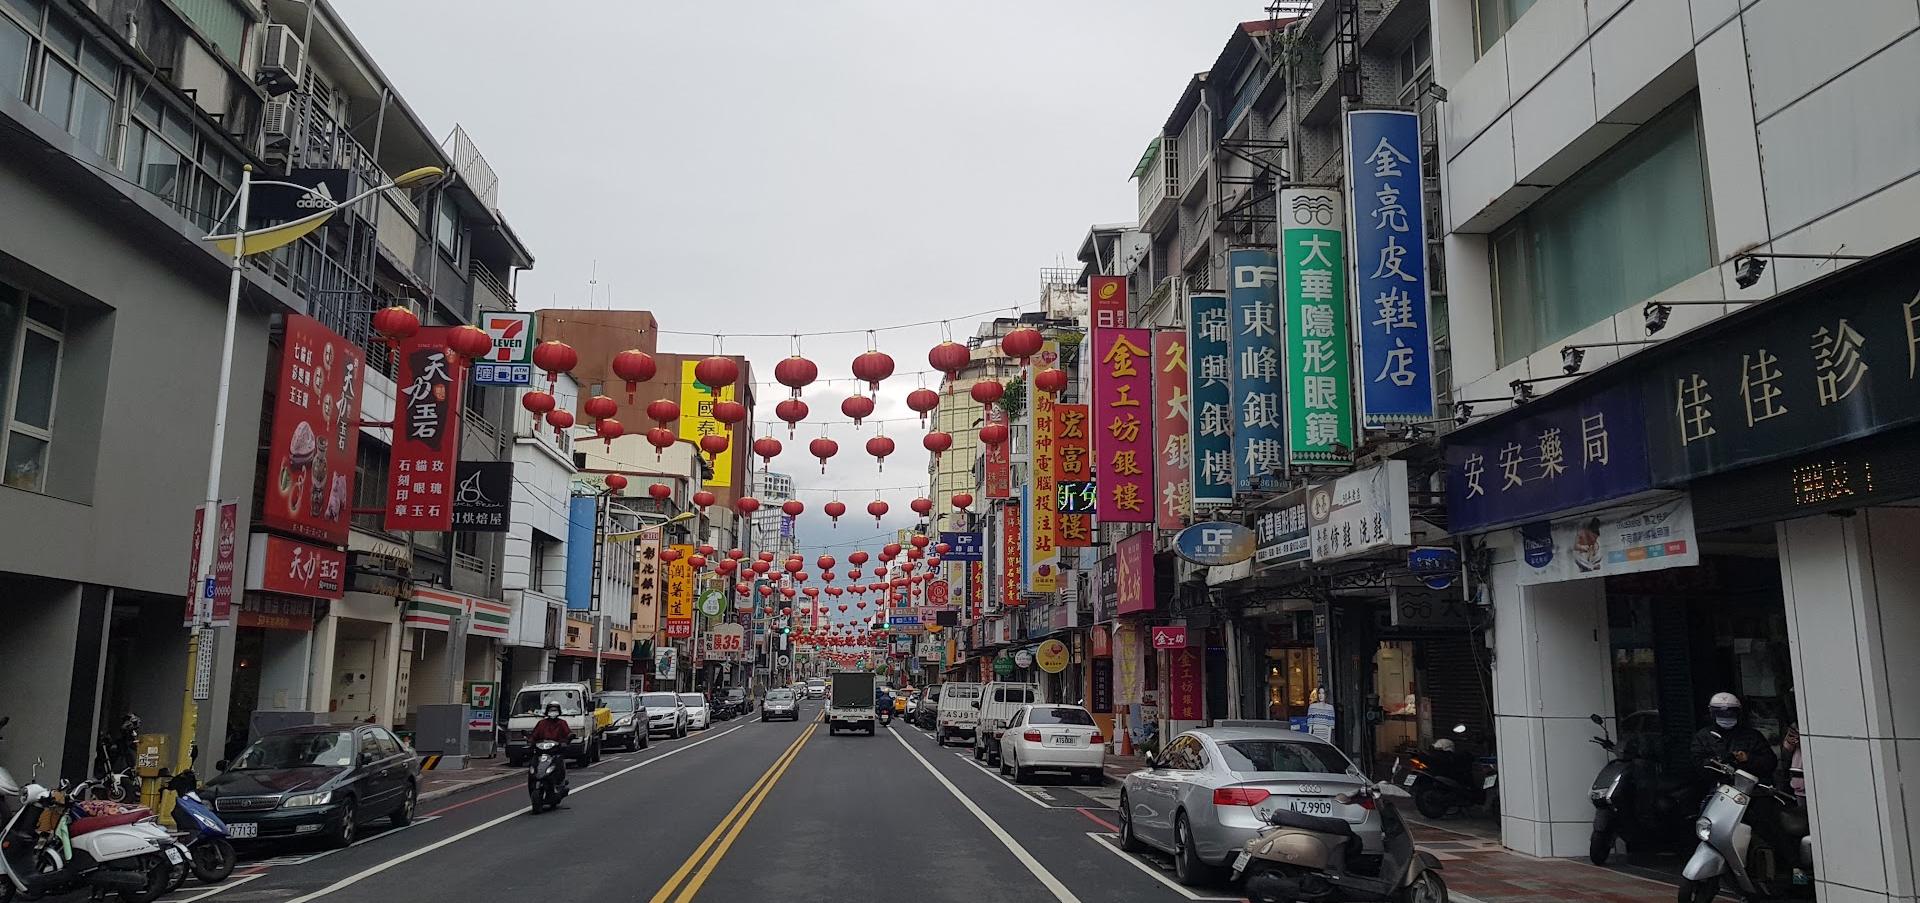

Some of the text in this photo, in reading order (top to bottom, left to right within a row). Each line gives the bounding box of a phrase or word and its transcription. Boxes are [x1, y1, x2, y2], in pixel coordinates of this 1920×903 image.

[1364, 136, 1417, 387] 金亮皮鞋店
[1198, 308, 1233, 486] 瑞興銀樓
[1240, 300, 1283, 477] 東峰銀樓
[1299, 233, 1340, 447] 大華隱形眼鏡
[394, 460, 411, 517] 石刻印章
[1036, 396, 1053, 552] 勒財神電腦投注站
[1059, 410, 1087, 540] 宏富樓
[1102, 333, 1150, 512] 金工坊銀樓
[1161, 340, 1191, 517] 久大銀樓
[1463, 412, 1610, 499] 安安藥局
[641, 546, 656, 607] 彰化銀行
[1117, 547, 1141, 605] 金工坊
[1155, 630, 1185, 646] 金工坊
[1178, 650, 1196, 718] 金工坊銀樓
